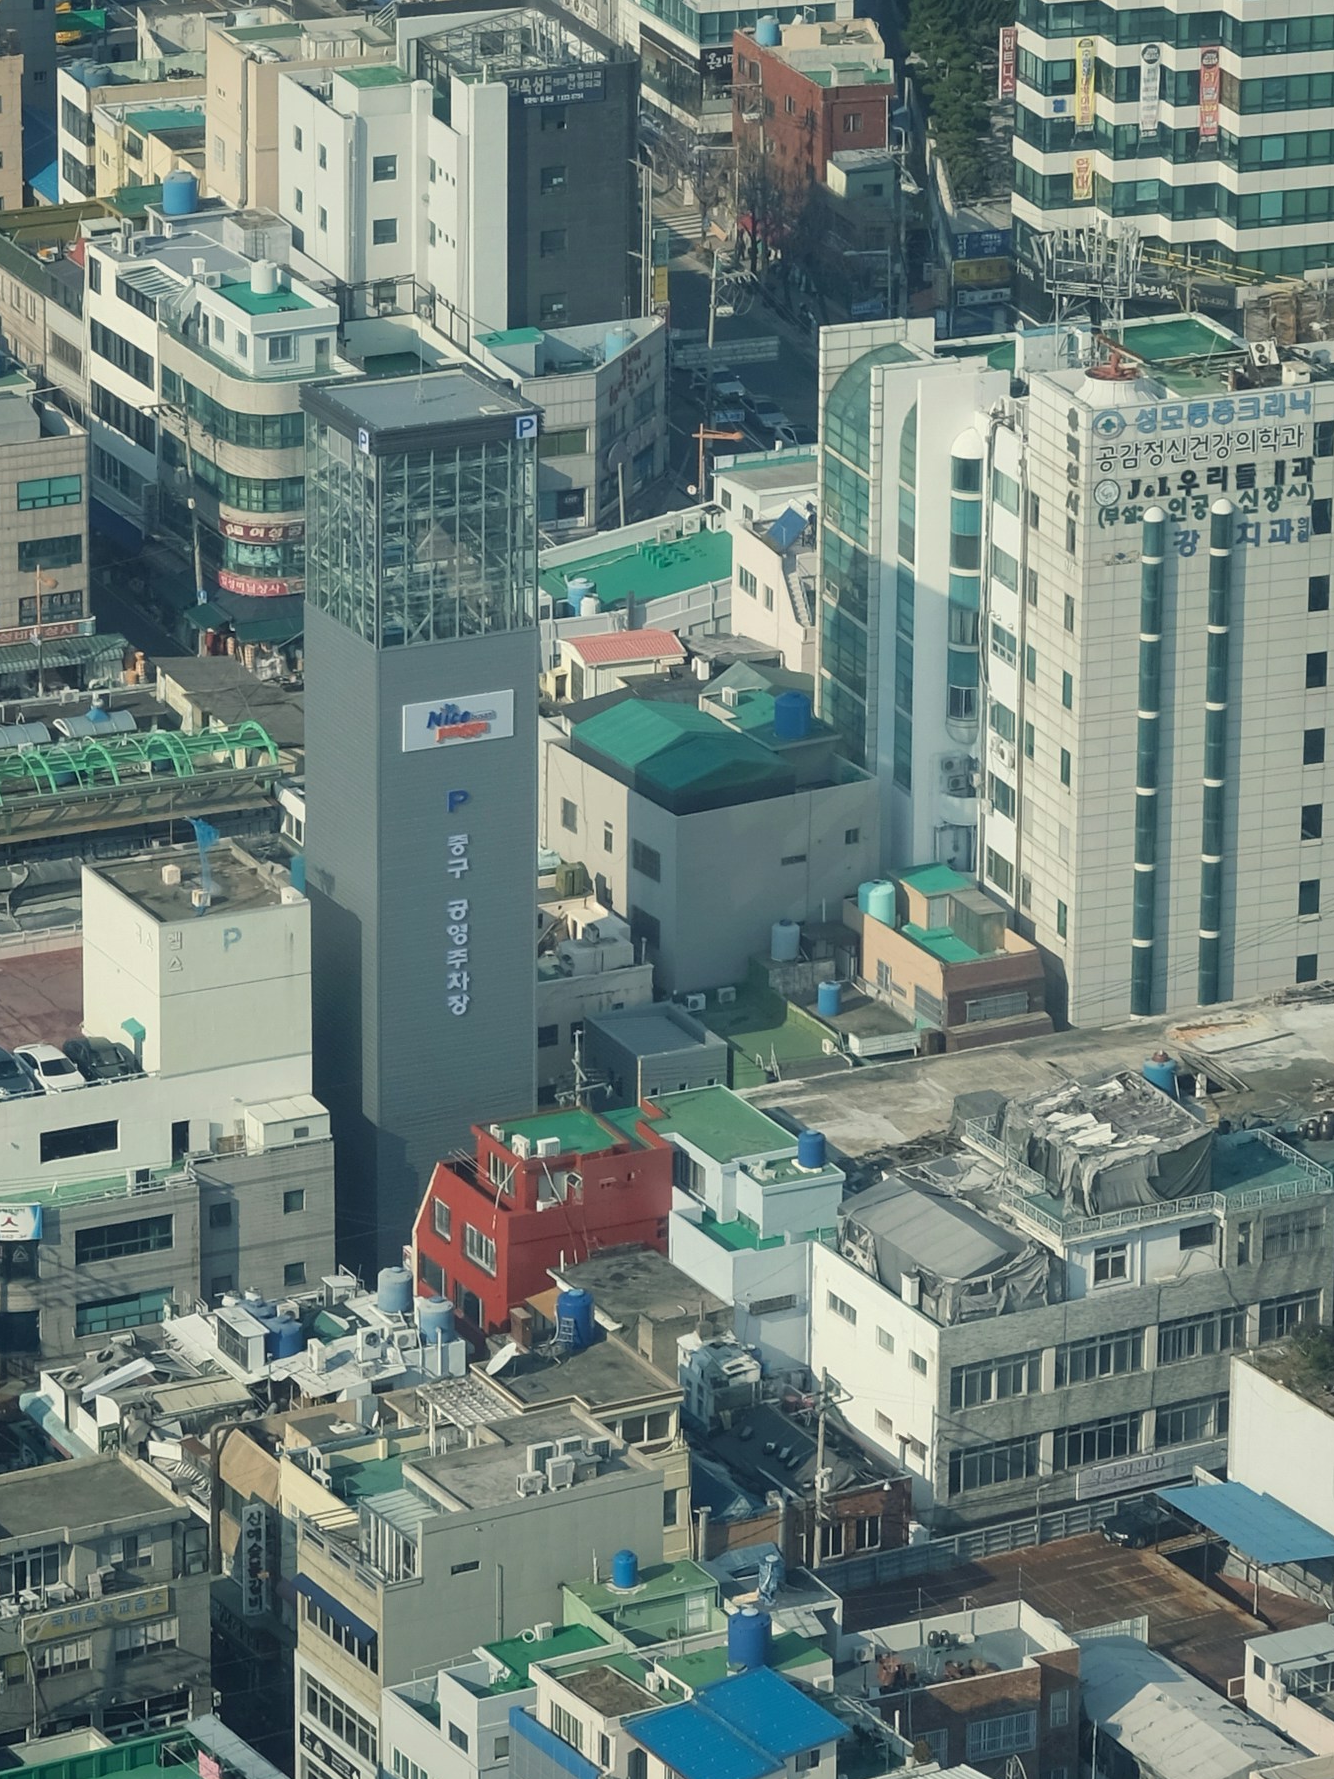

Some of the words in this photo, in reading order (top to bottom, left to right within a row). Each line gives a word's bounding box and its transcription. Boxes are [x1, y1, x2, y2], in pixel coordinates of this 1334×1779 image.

[519, 419, 534, 439] P
[1135, 391, 1313, 434] 성모통증크리닉
[1095, 424, 1305, 473] 공감정신건강의학과
[1167, 493, 1210, 523] 인공
[447, 789, 469, 813] P
[447, 833, 469, 880] 중구
[204, 934, 215, 948] P
[447, 897, 469, 1017] 공영주차장
